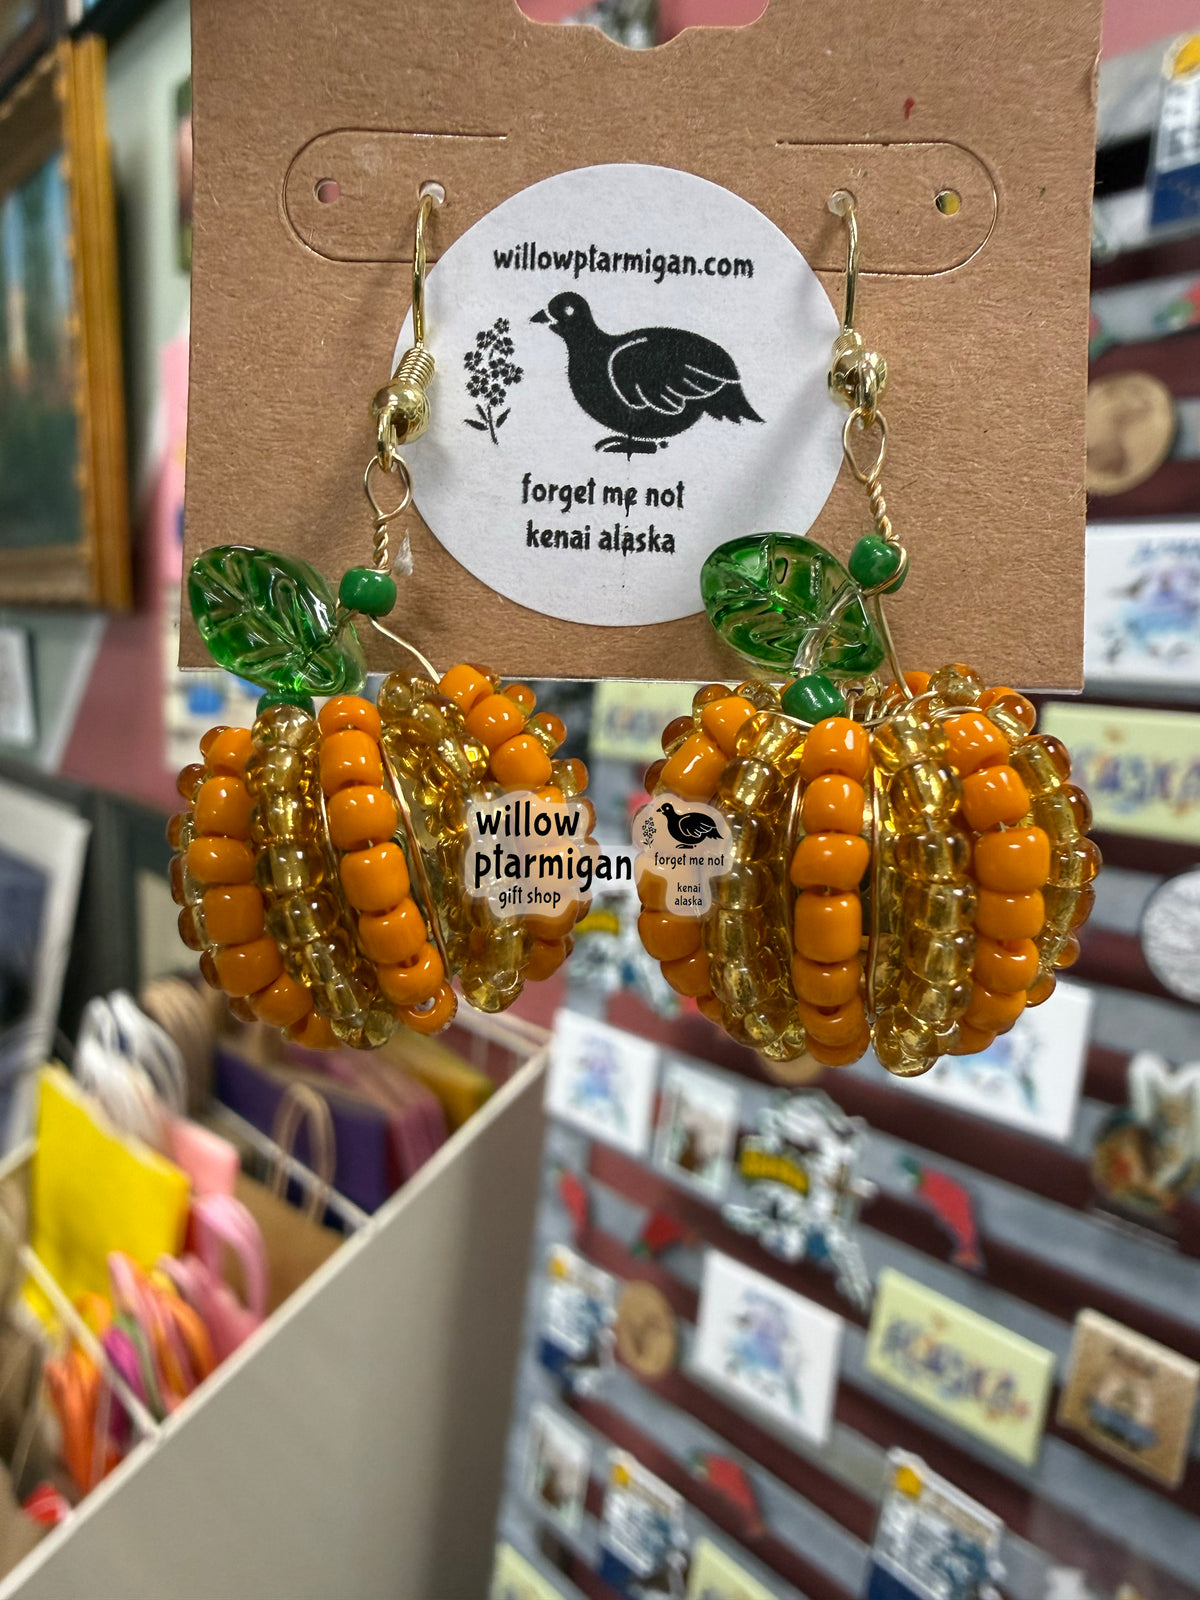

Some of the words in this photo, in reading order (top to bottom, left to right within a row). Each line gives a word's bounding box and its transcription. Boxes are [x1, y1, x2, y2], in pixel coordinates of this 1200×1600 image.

[493, 241, 755, 284] willowptarmigan.com
[521, 472, 596, 513] forget
[603, 485, 638, 514] me
[645, 481, 685, 509] not
[526, 520, 591, 551] kenai
[599, 522, 676, 555] alaska
